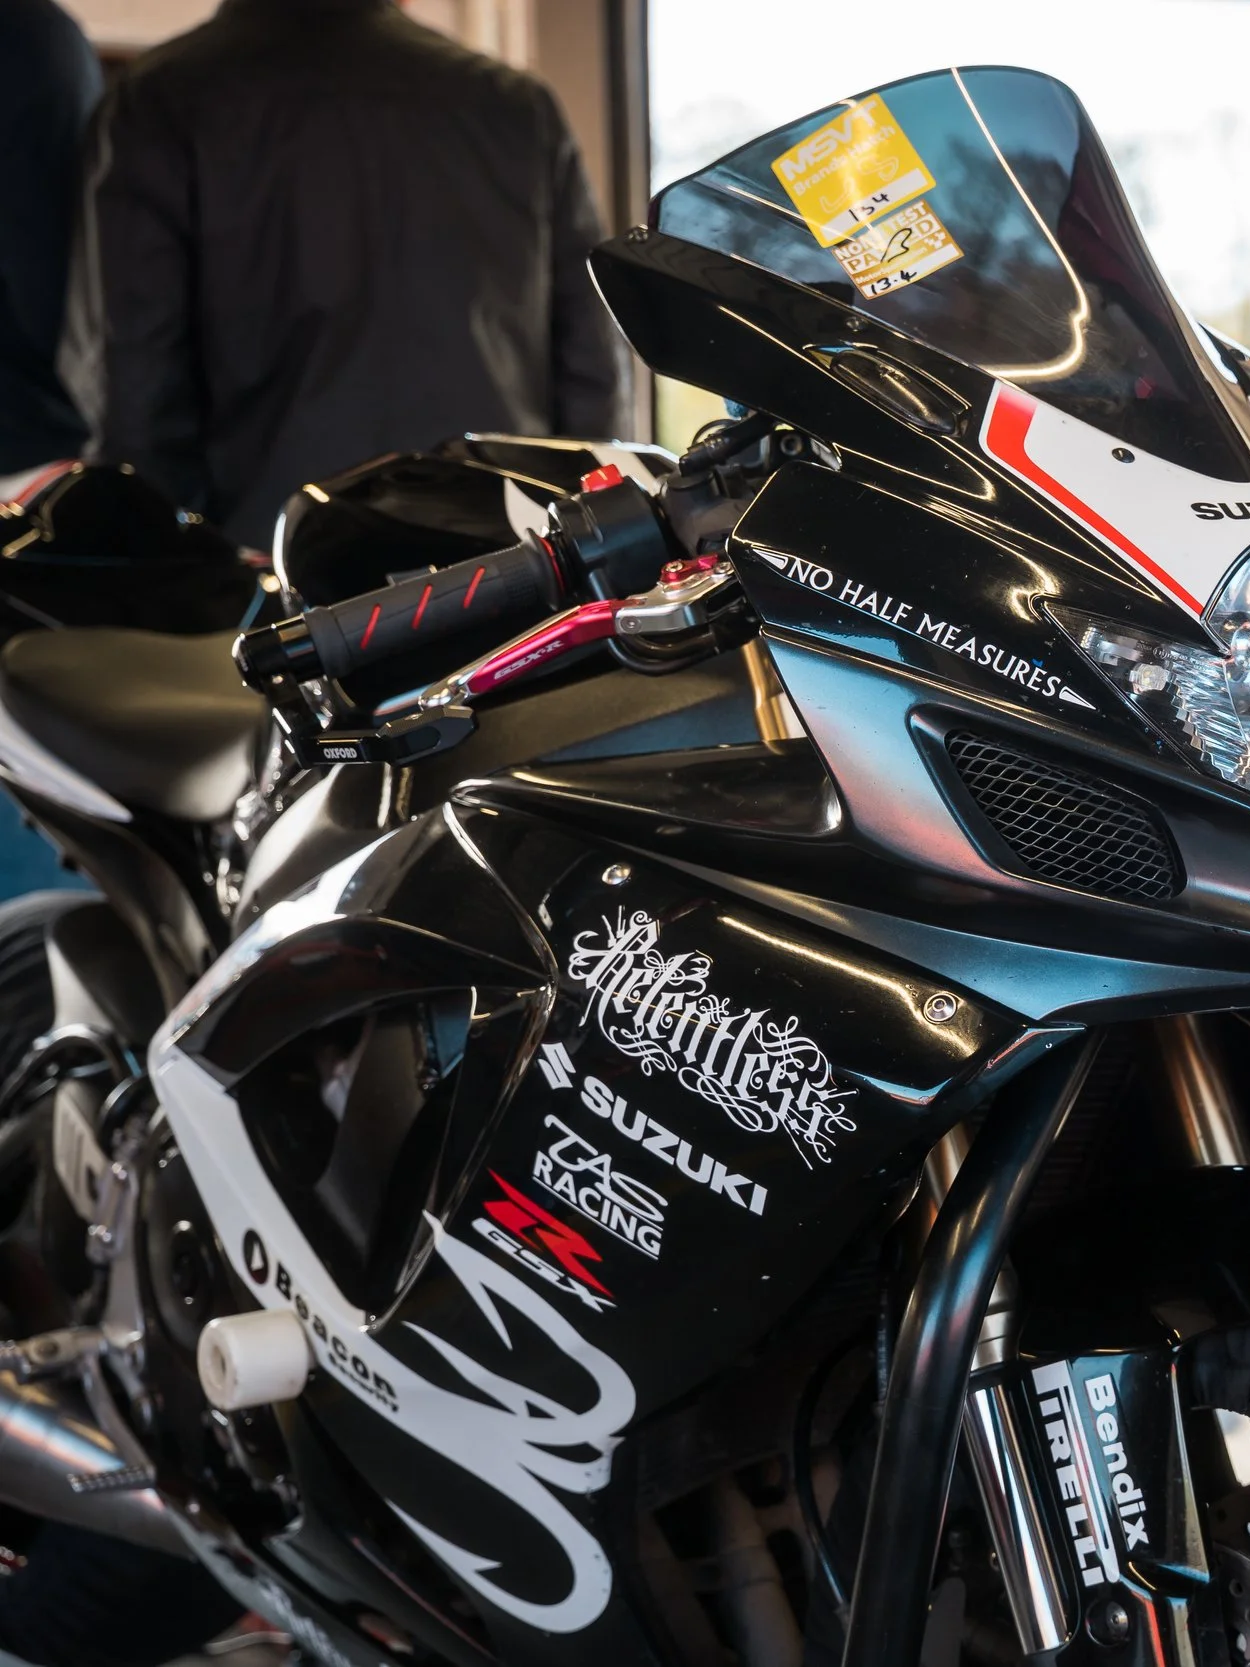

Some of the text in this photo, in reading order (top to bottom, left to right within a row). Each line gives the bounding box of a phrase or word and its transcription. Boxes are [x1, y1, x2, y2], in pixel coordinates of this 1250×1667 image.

[779, 100, 878, 182] MSVT
[793, 125, 896, 197] Brands Hatch
[787, 558, 1062, 698] NO HALF MEASURES
[323, 747, 358, 759] OXFORD
[531, 1150, 663, 1259] RACING
[543, 1113, 669, 1224] TAS
[580, 1075, 768, 1216] SUZUKI
[275, 1261, 397, 1399] Beacon
[1031, 1359, 1105, 1588] PIRELLI
[1084, 1373, 1150, 1551] Bendix
